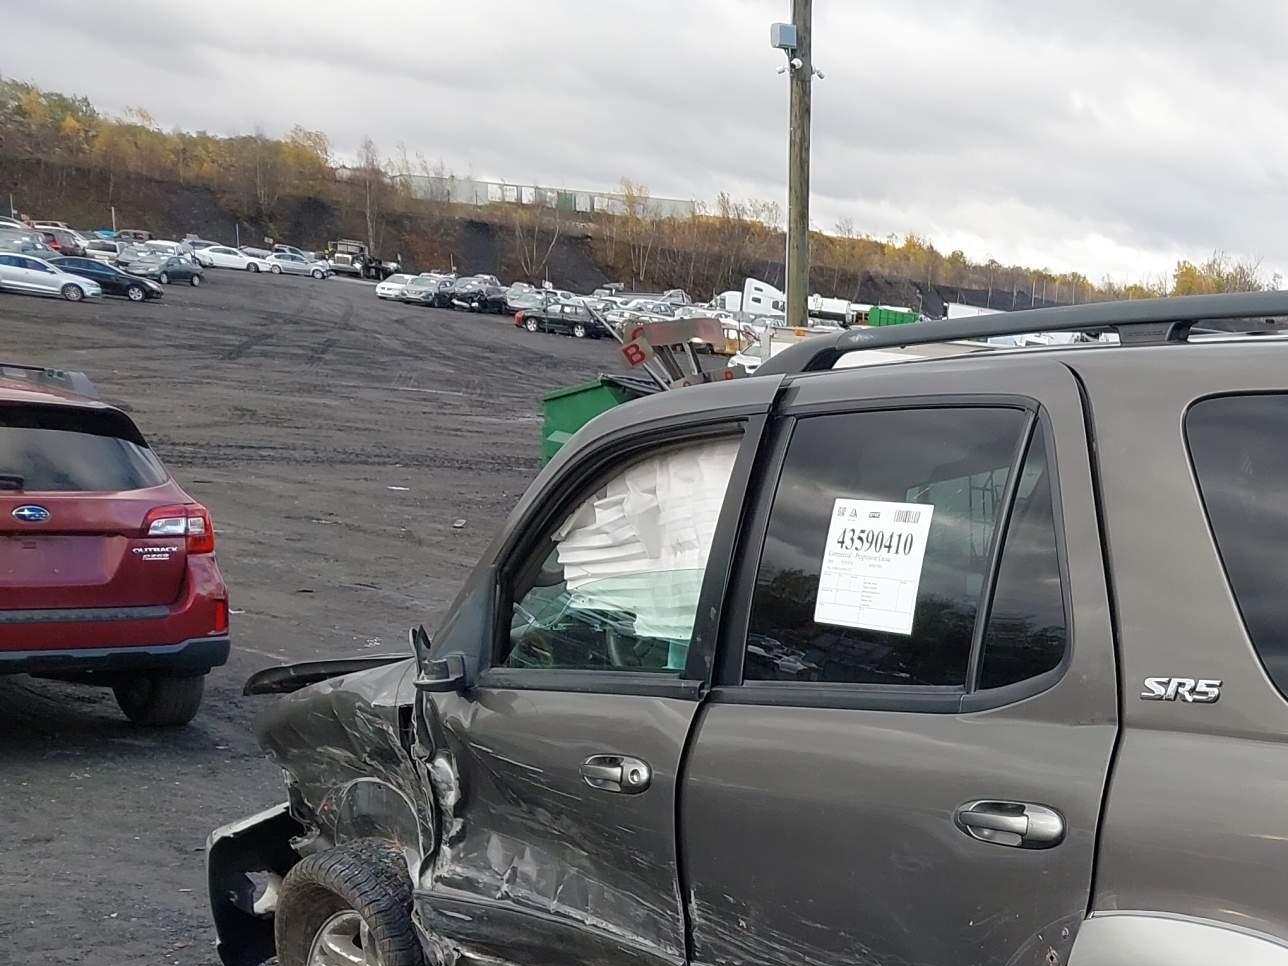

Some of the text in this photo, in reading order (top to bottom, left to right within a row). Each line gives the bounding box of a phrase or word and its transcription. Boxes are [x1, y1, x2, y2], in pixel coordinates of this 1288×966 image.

[622, 343, 646, 366] B
[132, 546, 178, 555] OUTBACK
[837, 528, 914, 556] 43590410
[1140, 677, 1223, 704] SR5
